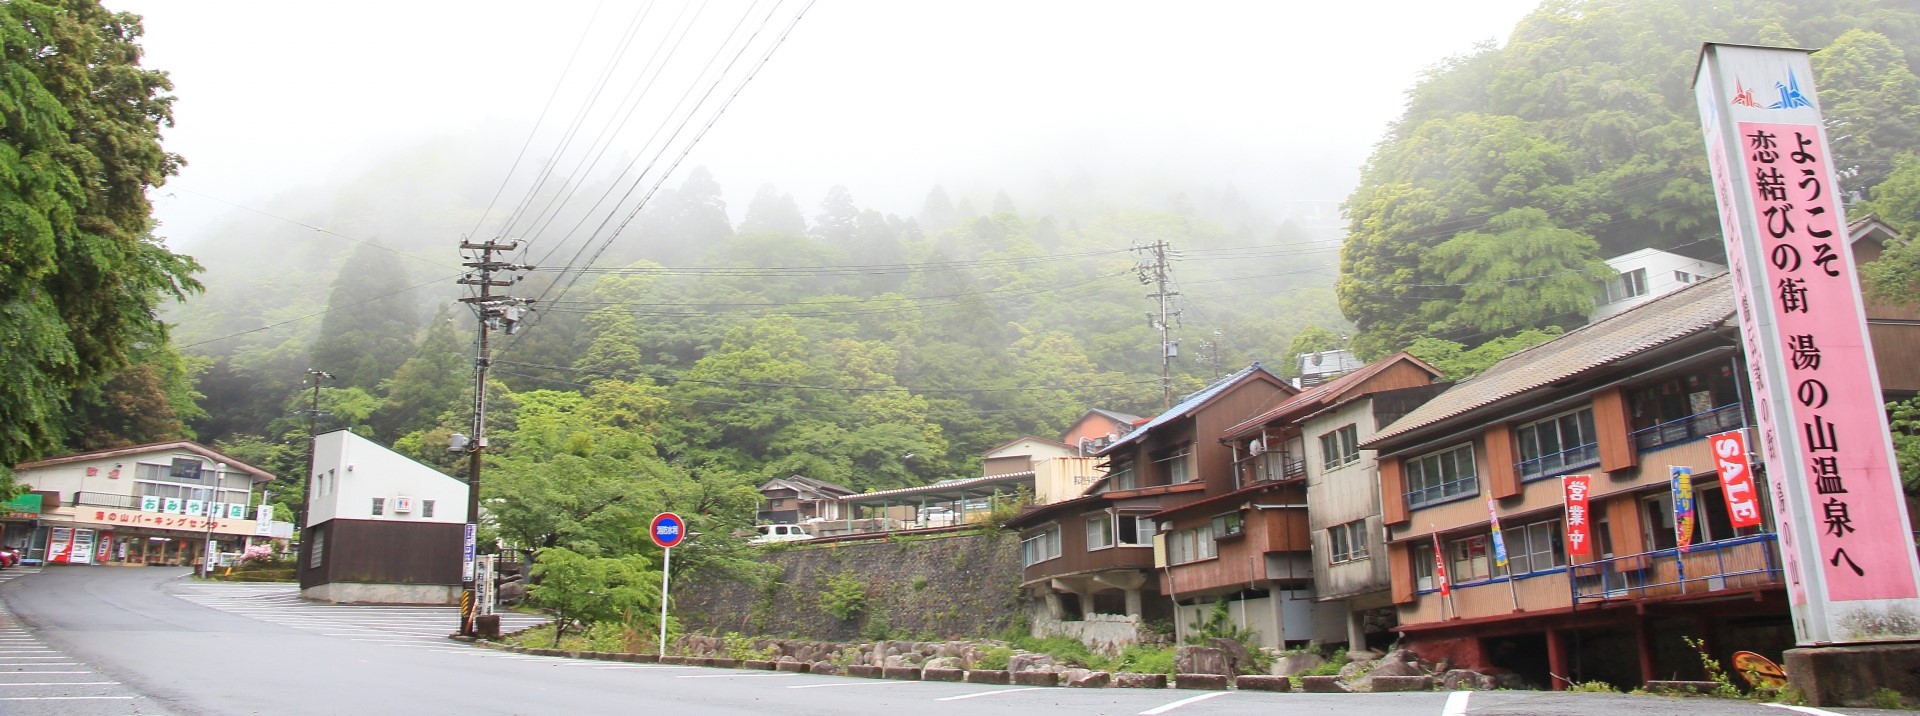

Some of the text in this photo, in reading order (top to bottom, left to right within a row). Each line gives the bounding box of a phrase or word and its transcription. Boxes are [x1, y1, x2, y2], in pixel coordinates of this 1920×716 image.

[1790, 132, 1840, 277] ようこそ
[1746, 130, 1864, 577] 恋結びの街 湯の山温泉へ
[95, 511, 228, 530] 湯の山パーキングセンター
[1567, 480, 1588, 551] 営業中
[1715, 438, 1758, 522] SALE
